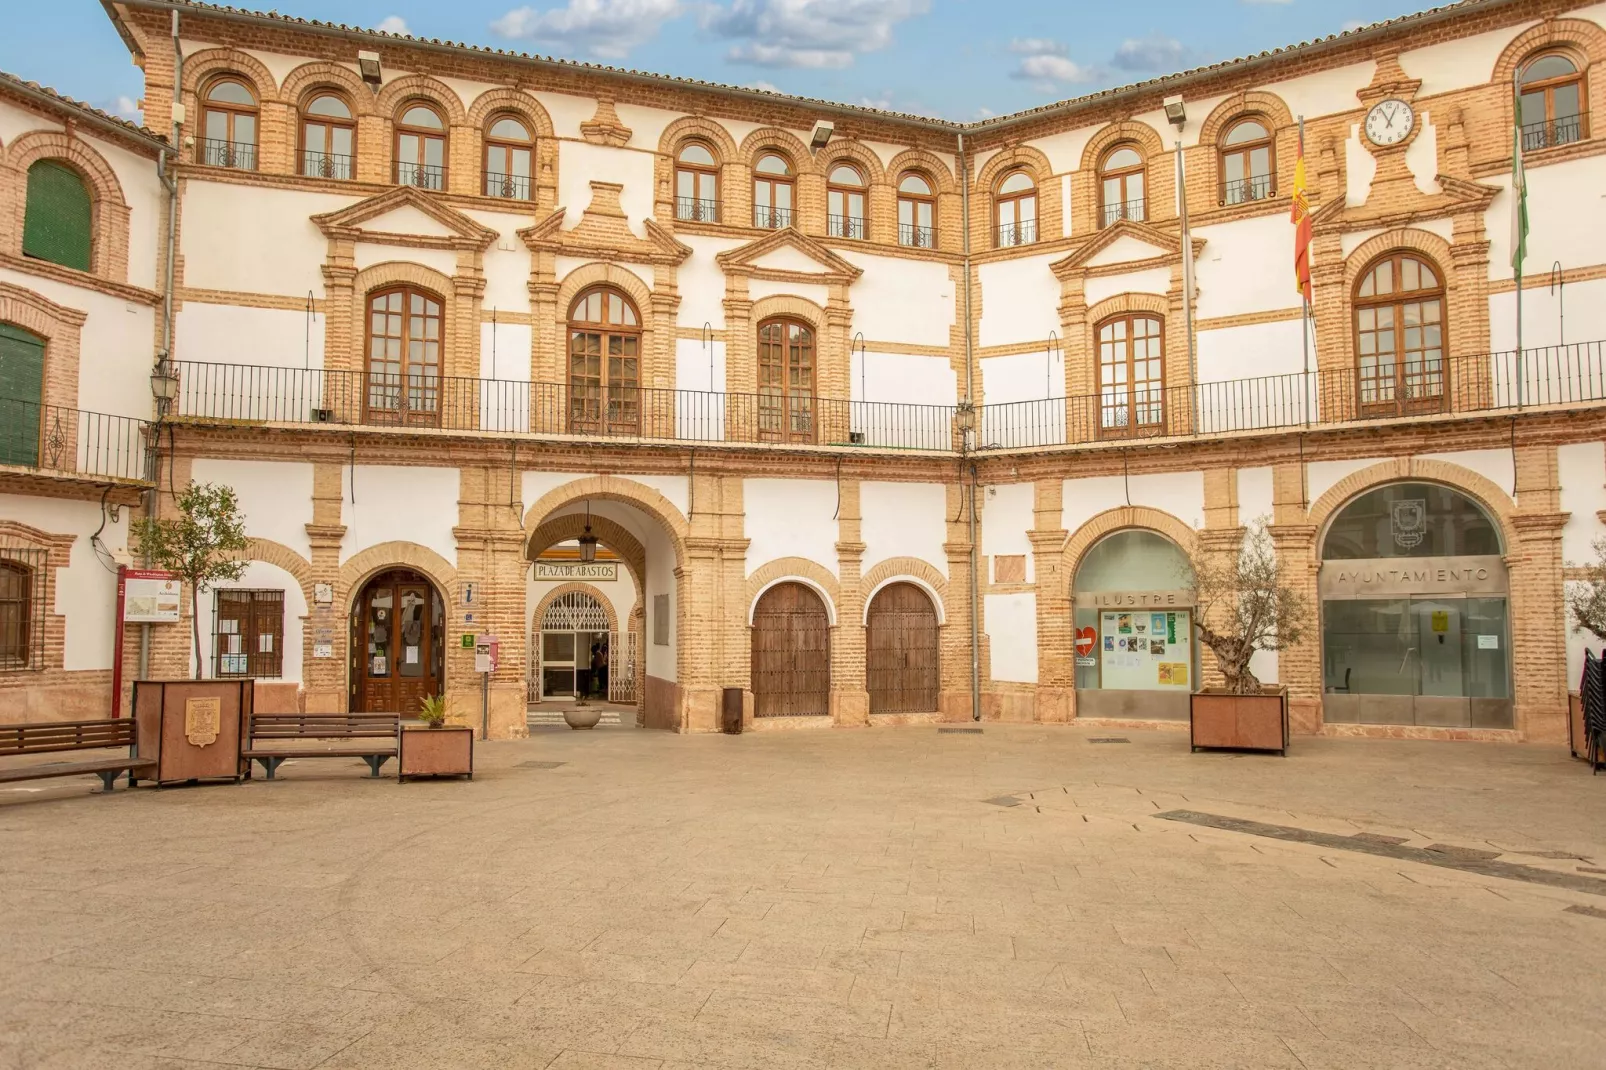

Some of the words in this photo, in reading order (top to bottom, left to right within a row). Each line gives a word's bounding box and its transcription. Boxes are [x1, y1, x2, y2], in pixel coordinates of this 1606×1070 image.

[538, 565, 564, 577] PLAZA
[565, 566, 575, 576] DE
[576, 566, 614, 577] ABASTOS
[1338, 568, 1489, 584] AYUNTAMIENTO
[1094, 594, 1175, 606] ILUSTRE
